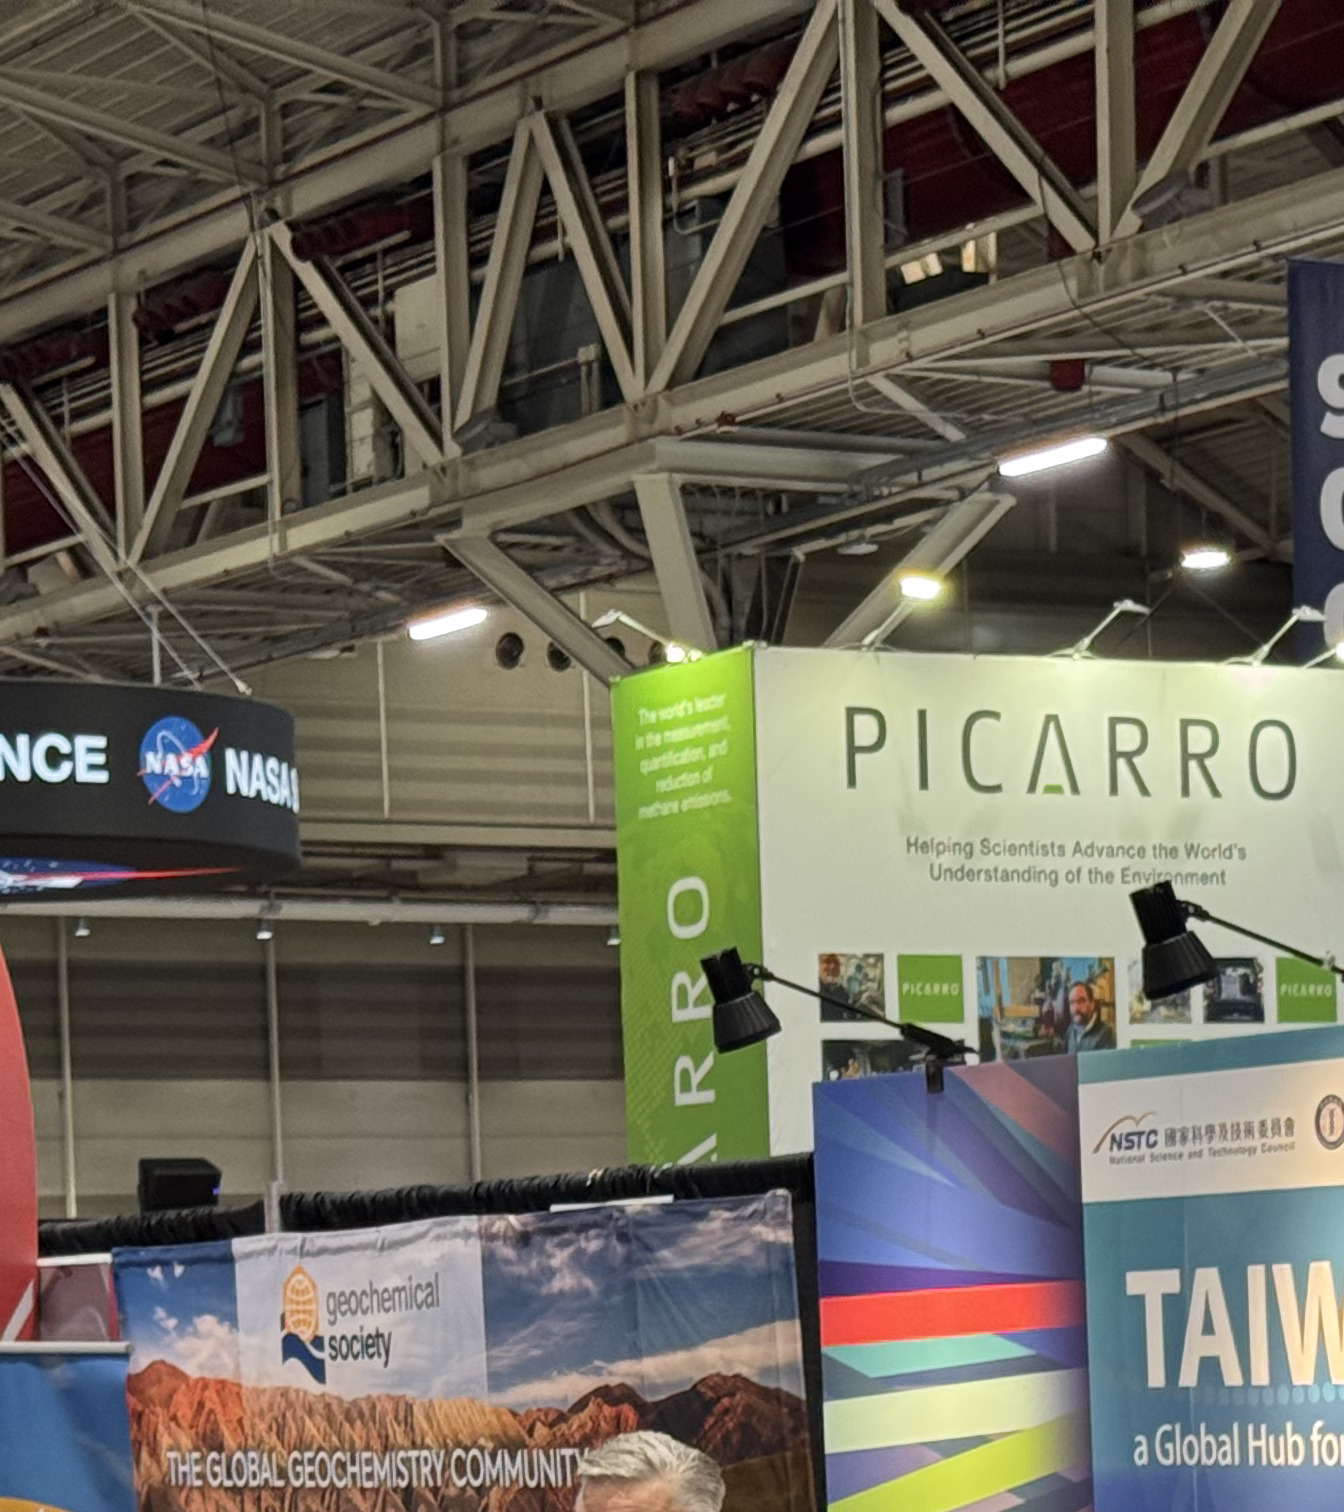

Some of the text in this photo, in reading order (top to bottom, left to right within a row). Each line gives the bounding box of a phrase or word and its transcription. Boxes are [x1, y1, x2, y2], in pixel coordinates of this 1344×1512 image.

[844, 706, 1298, 801] PICARRO
[906, 836, 1248, 862] Helping Scientists Advance the World's
[929, 863, 1226, 887] Understanding of the Environment
[902, 981, 960, 998] PICARRO
[1279, 982, 1333, 999] PICARRO
[1109, 1129, 1159, 1153] NSTC
[1149, 1152, 1184, 1164] Science
[1187, 1149, 1203, 1160] and
[1208, 1146, 1257, 1158] Technology
[1261, 1141, 1296, 1154] Council
[325, 1272, 441, 1322] geochemical
[328, 1327, 392, 1370] society
[1133, 1431, 1149, 1467] a
[1156, 1421, 1241, 1468] Global
[1247, 1421, 1305, 1467] Hub
[167, 1450, 203, 1487] THE
[206, 1450, 286, 1488] GLOBAL
[288, 1448, 444, 1489] GEOCHEMISTRY
